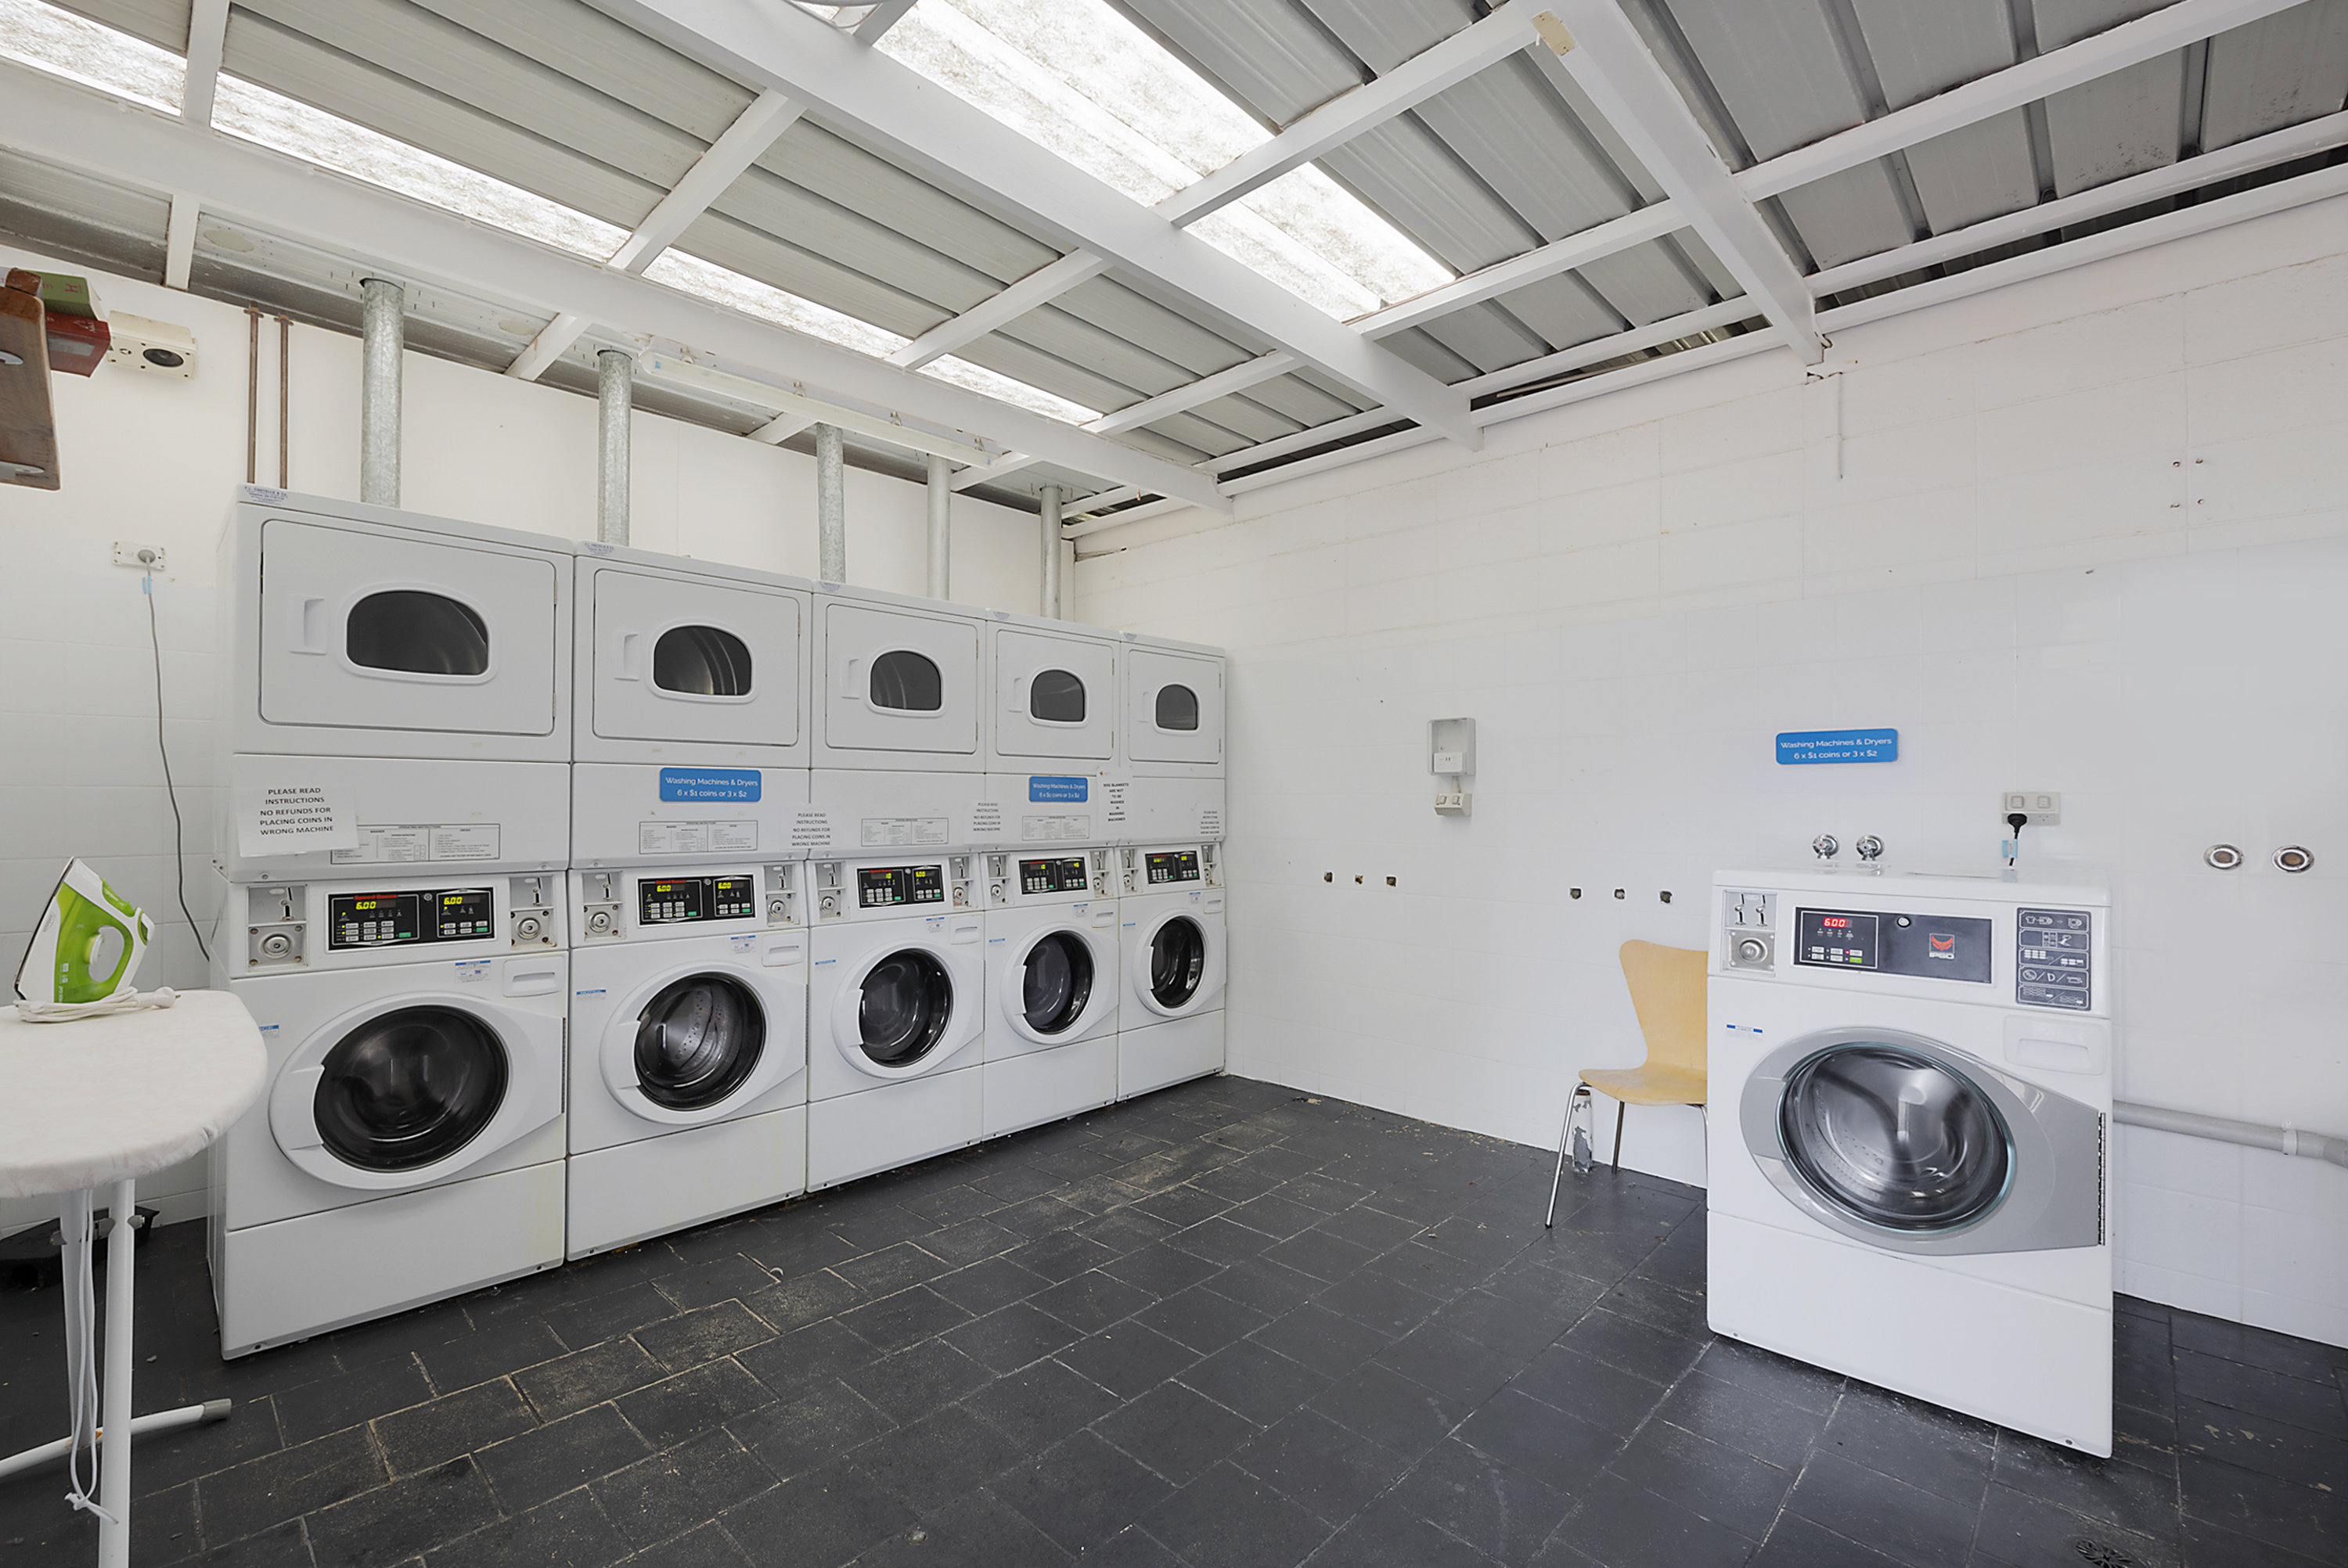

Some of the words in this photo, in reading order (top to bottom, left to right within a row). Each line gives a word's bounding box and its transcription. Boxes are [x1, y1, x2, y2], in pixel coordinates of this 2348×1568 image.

[665, 777, 696, 786] Washing
[444, 896, 462, 905] 6.00
[356, 901, 376, 910] 6.00
